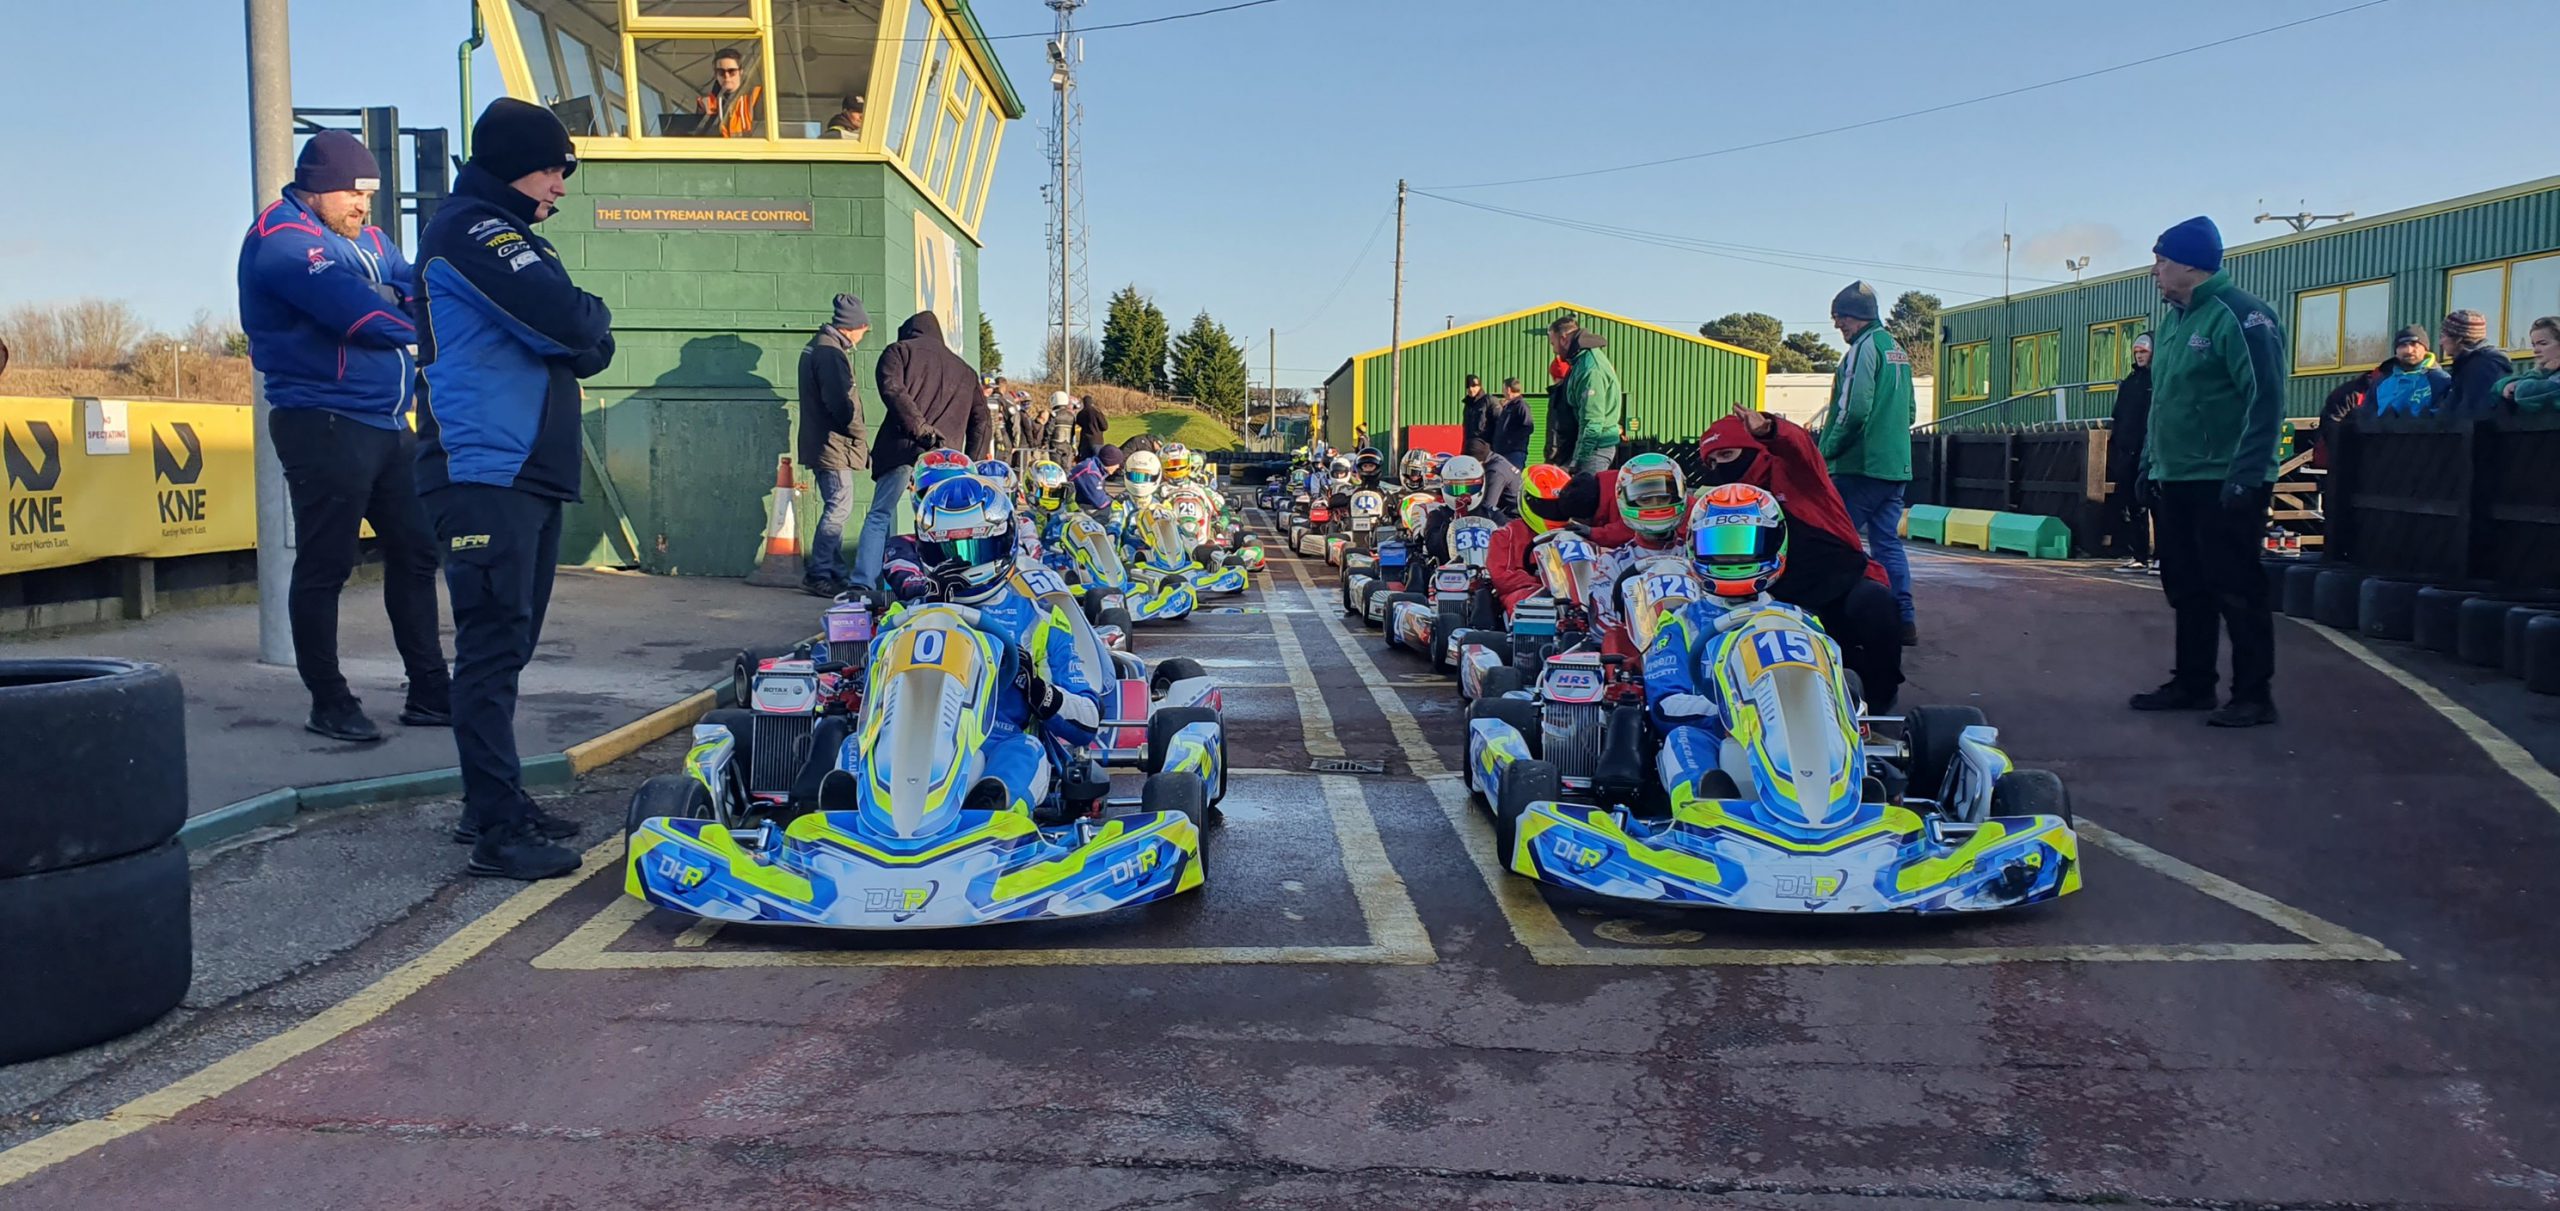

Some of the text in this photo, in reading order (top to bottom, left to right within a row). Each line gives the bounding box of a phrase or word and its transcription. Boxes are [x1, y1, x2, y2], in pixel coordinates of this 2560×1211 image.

[598, 209, 810, 222] THE TOM TYREMAN RACE CONTROL
[88, 430, 126, 440] SPECTATING
[157, 489, 206, 523] KNE
[1179, 502, 1196, 515] 29
[1358, 496, 1375, 510] 44
[9, 496, 65, 536] KNE
[1716, 515, 1749, 525] BCR
[1457, 530, 1490, 550] 36
[913, 630, 944, 663] 0
[1758, 630, 1816, 663] 15
[1557, 675, 1590, 685] HRS
[1553, 836, 1601, 867] DHR
[659, 854, 703, 887] DHR
[1108, 849, 1157, 885] DHR
[1773, 874, 1838, 897] DHR
[864, 887, 928, 911] DHR
